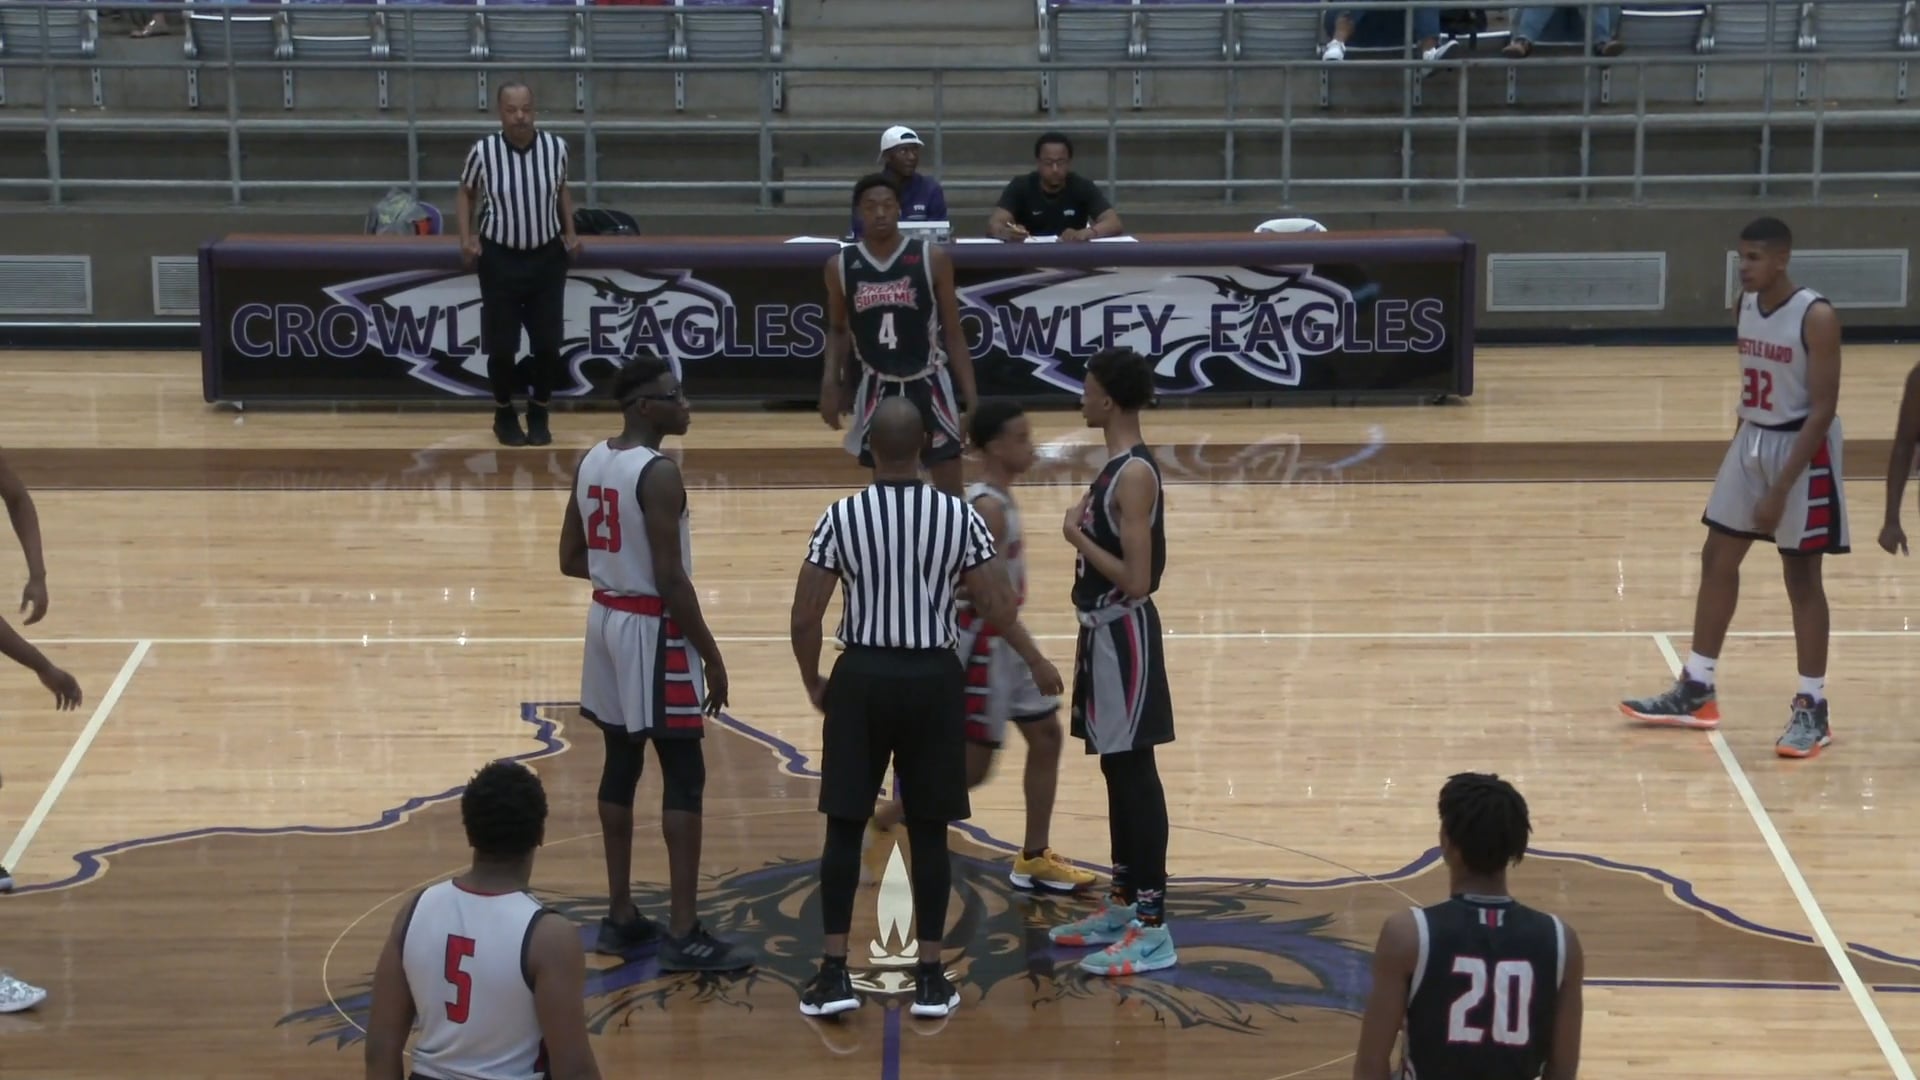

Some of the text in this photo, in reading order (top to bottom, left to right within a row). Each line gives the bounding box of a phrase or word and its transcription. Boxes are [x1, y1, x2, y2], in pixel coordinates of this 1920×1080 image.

[855, 292, 914, 309] SUPREME
[959, 298, 1446, 359] OWLEY EAGLES
[231, 303, 826, 358] CROWL EAGLES
[878, 312, 898, 350] 4
[1742, 367, 1773, 411] 32
[587, 484, 622, 553] 23
[444, 933, 476, 1024] 5
[1447, 955, 1534, 1046] 20
